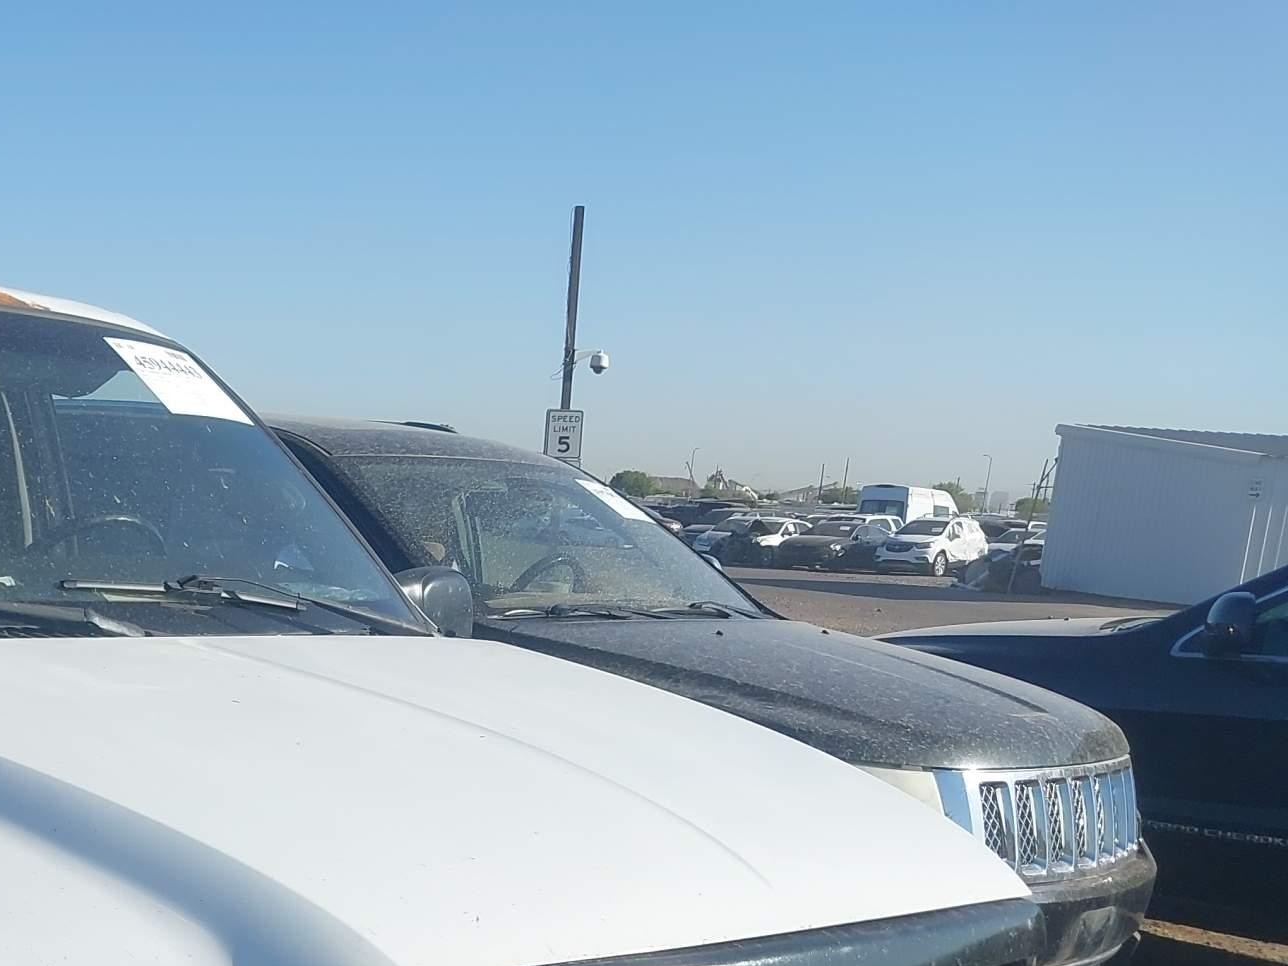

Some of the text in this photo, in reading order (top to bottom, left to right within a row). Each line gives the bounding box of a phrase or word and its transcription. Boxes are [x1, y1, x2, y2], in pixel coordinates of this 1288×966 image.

[551, 415, 581, 423] SPEED
[553, 425, 577, 433] LIMIT
[557, 435, 570, 453] 5
[1204, 828, 1288, 848] CHEROK
